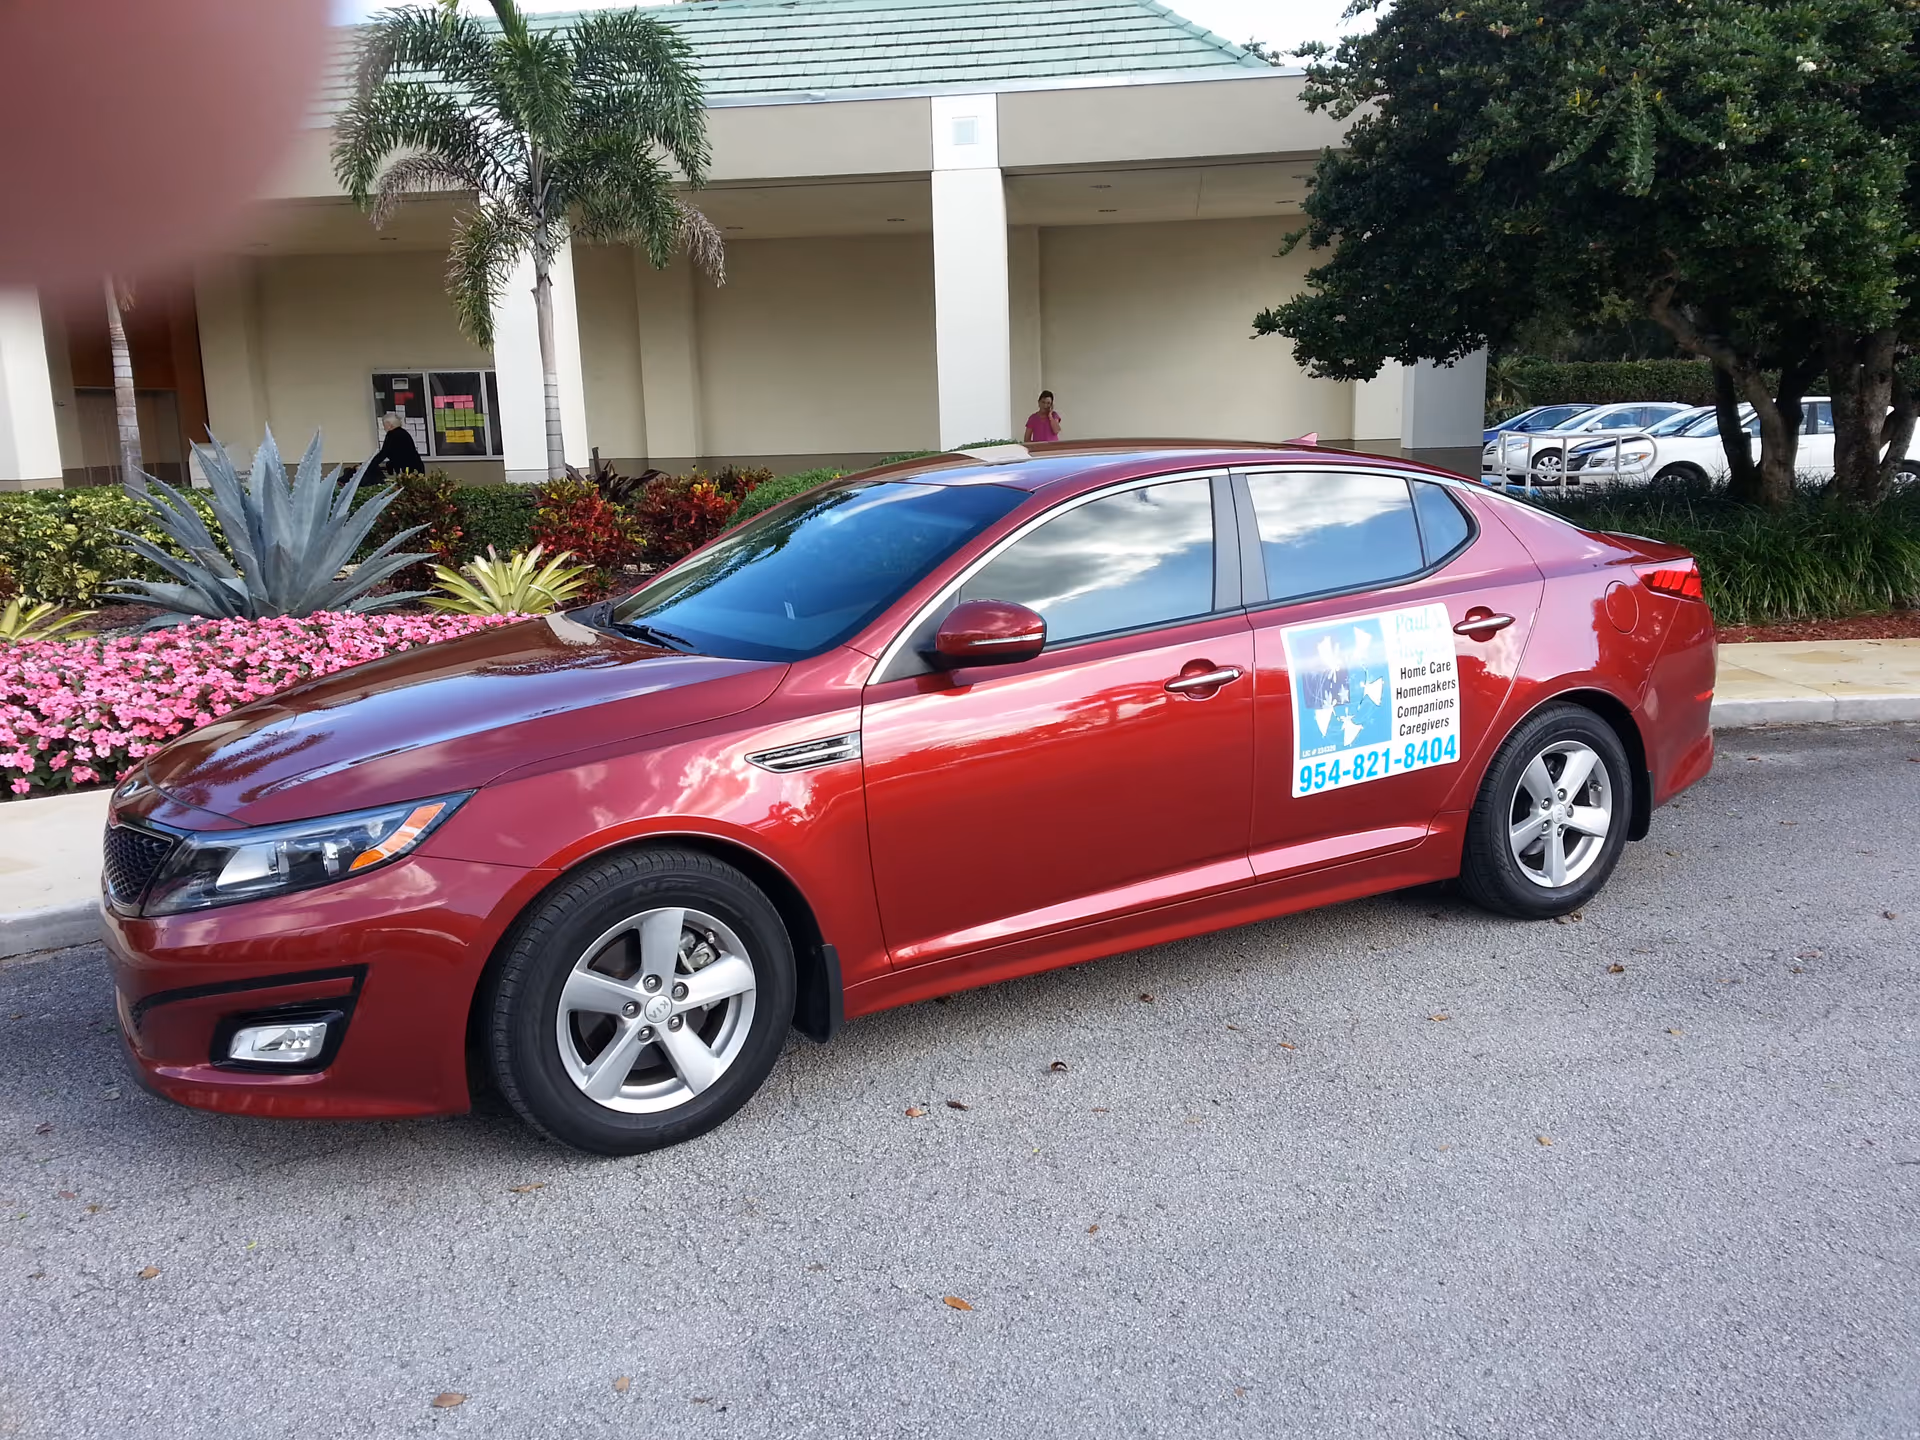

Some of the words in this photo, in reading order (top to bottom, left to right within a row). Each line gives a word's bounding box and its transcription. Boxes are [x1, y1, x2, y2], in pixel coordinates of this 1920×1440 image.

[1400, 667, 1426, 680] Home
[1429, 661, 1451, 675] Care
[1396, 679, 1456, 700] Homemakers
[1397, 698, 1454, 719] Companions
[1399, 717, 1450, 737] Caregivers
[1299, 734, 1457, 793] 954-821-8404
[648, 1000, 669, 1018] KIA
